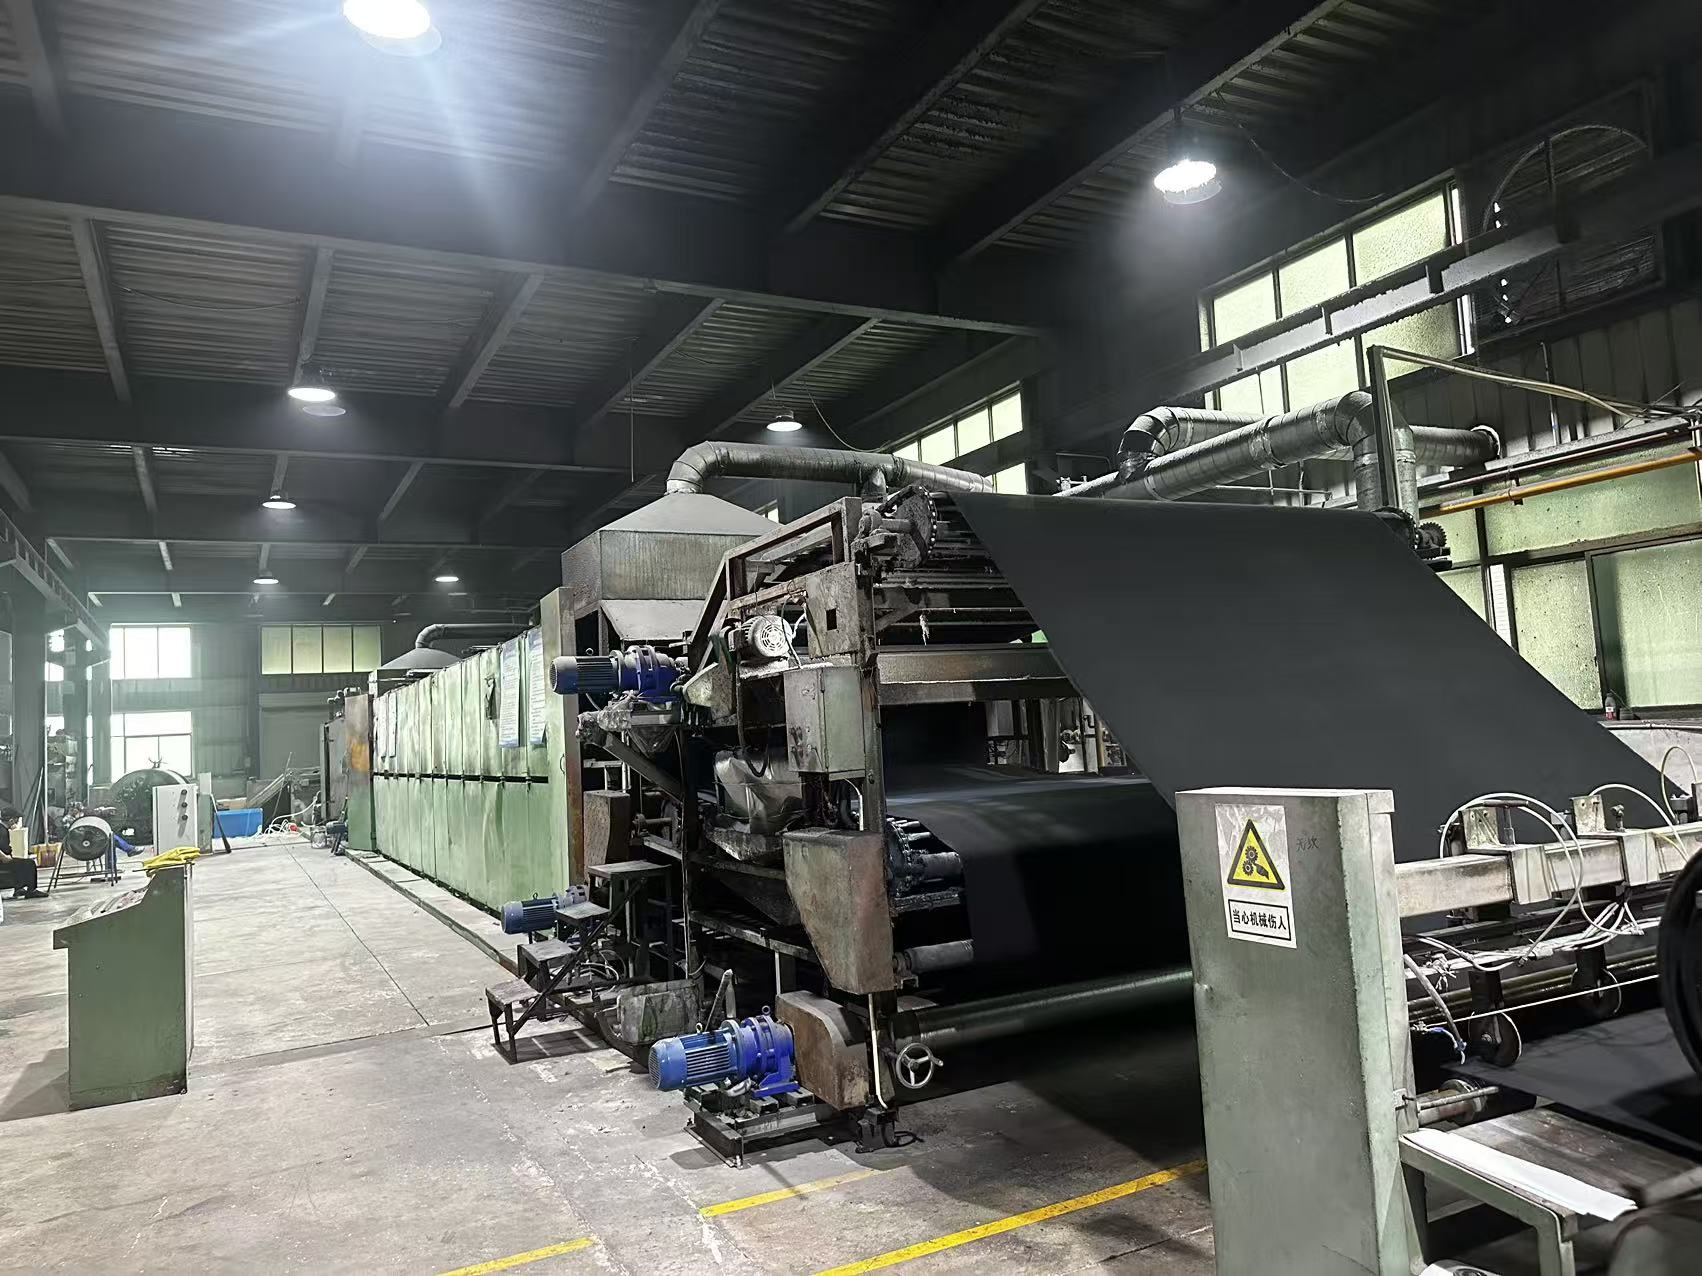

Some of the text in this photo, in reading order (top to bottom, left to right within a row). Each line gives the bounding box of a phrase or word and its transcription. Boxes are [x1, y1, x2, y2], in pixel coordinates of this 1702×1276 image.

[1233, 909, 1286, 930] 当心机械伤人
